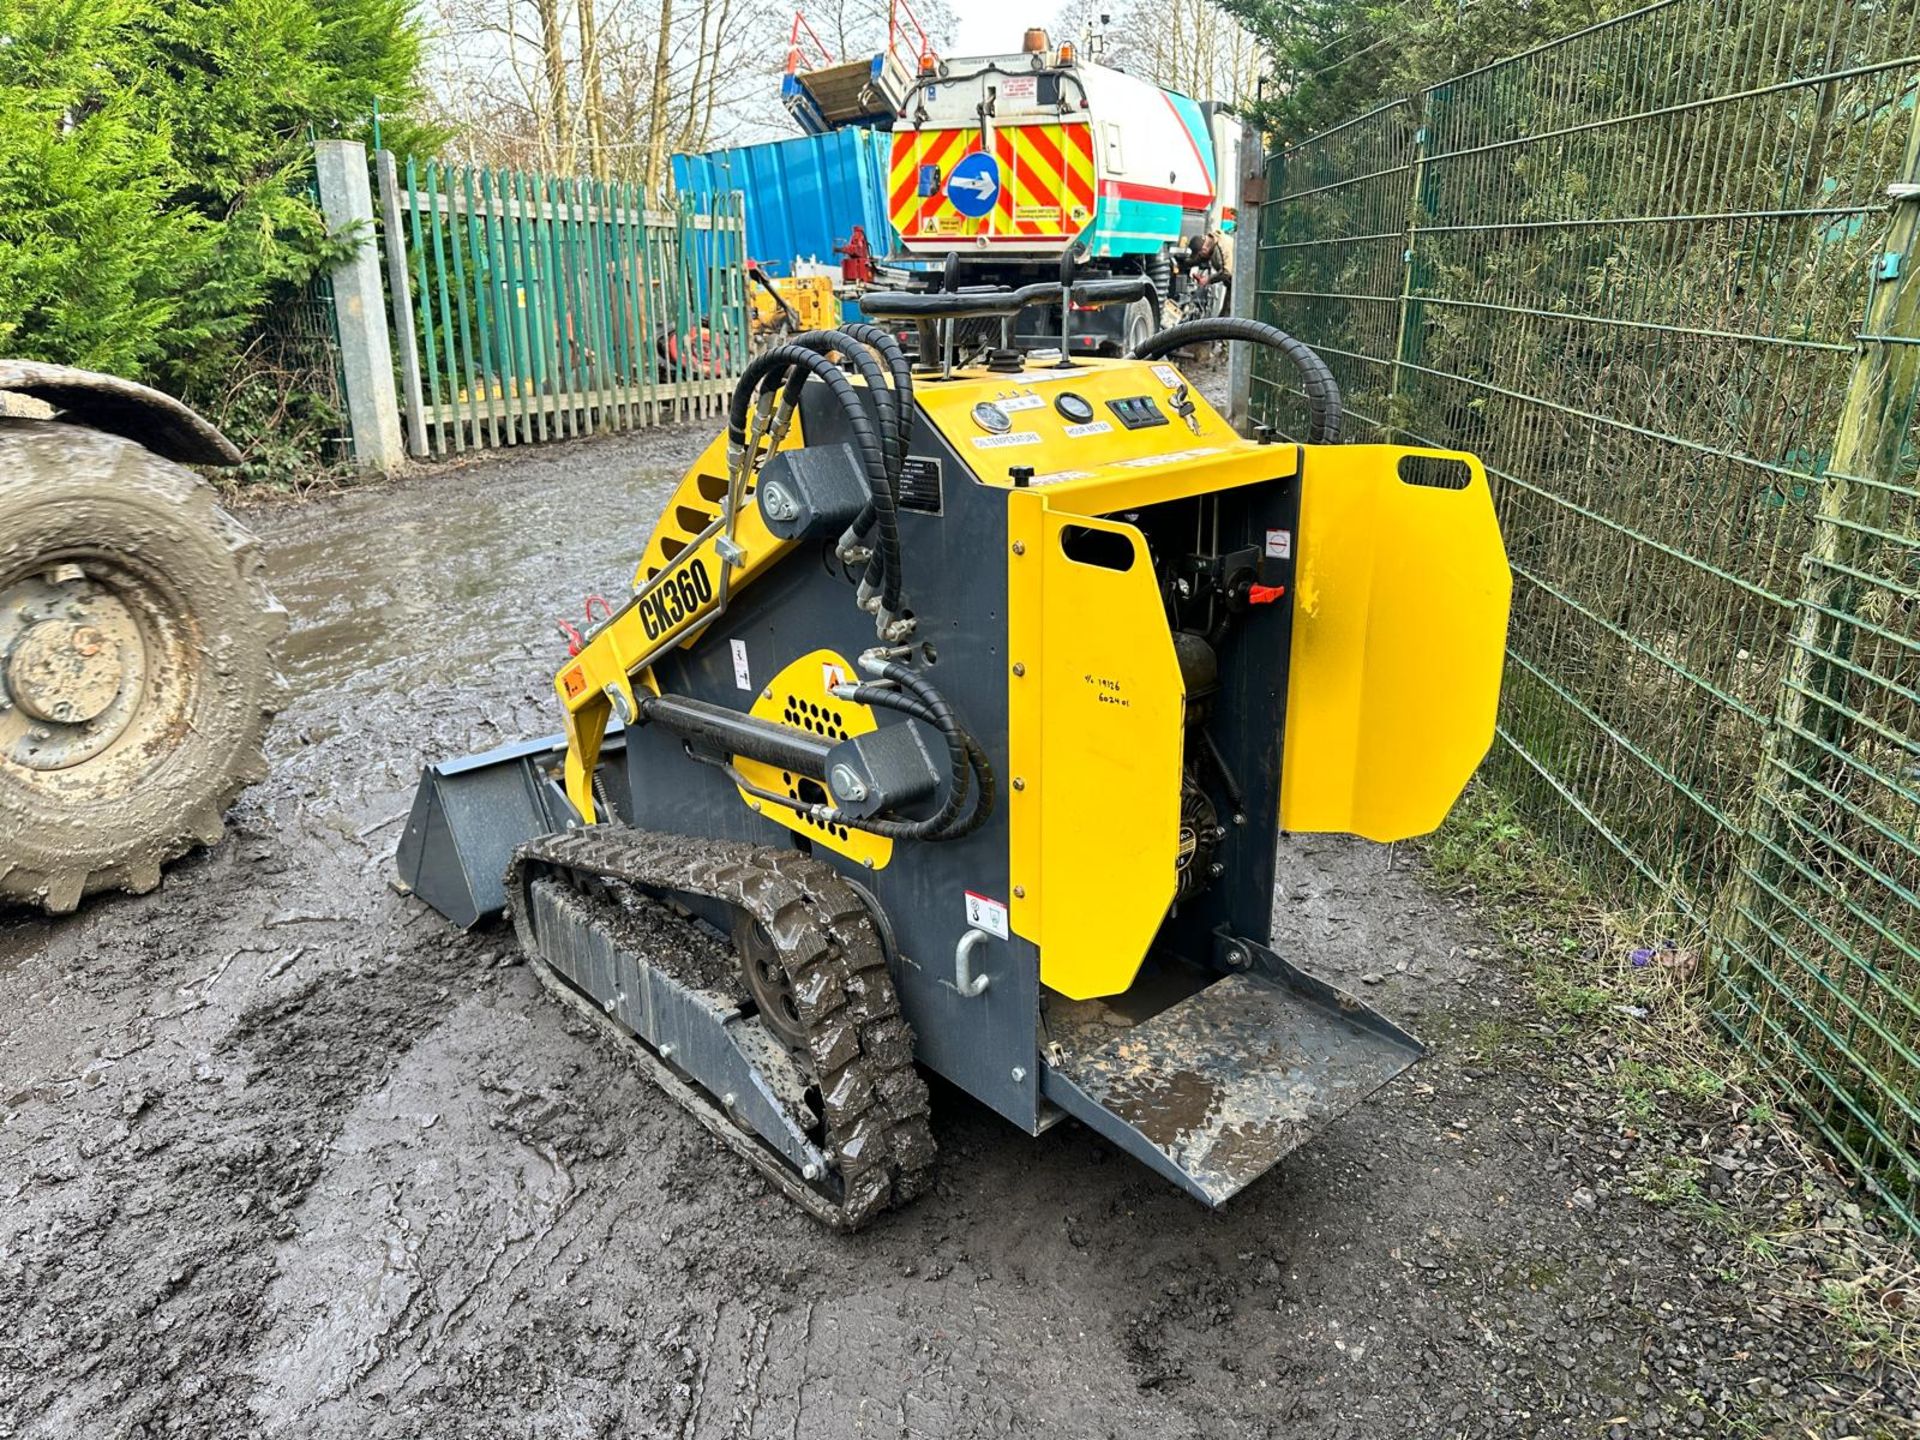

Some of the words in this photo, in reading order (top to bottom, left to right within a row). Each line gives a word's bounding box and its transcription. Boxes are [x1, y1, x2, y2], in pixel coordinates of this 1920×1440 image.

[1068, 426, 1086, 435] HOUR
[1086, 423, 1109, 432] METER
[639, 558, 712, 641] CK360
